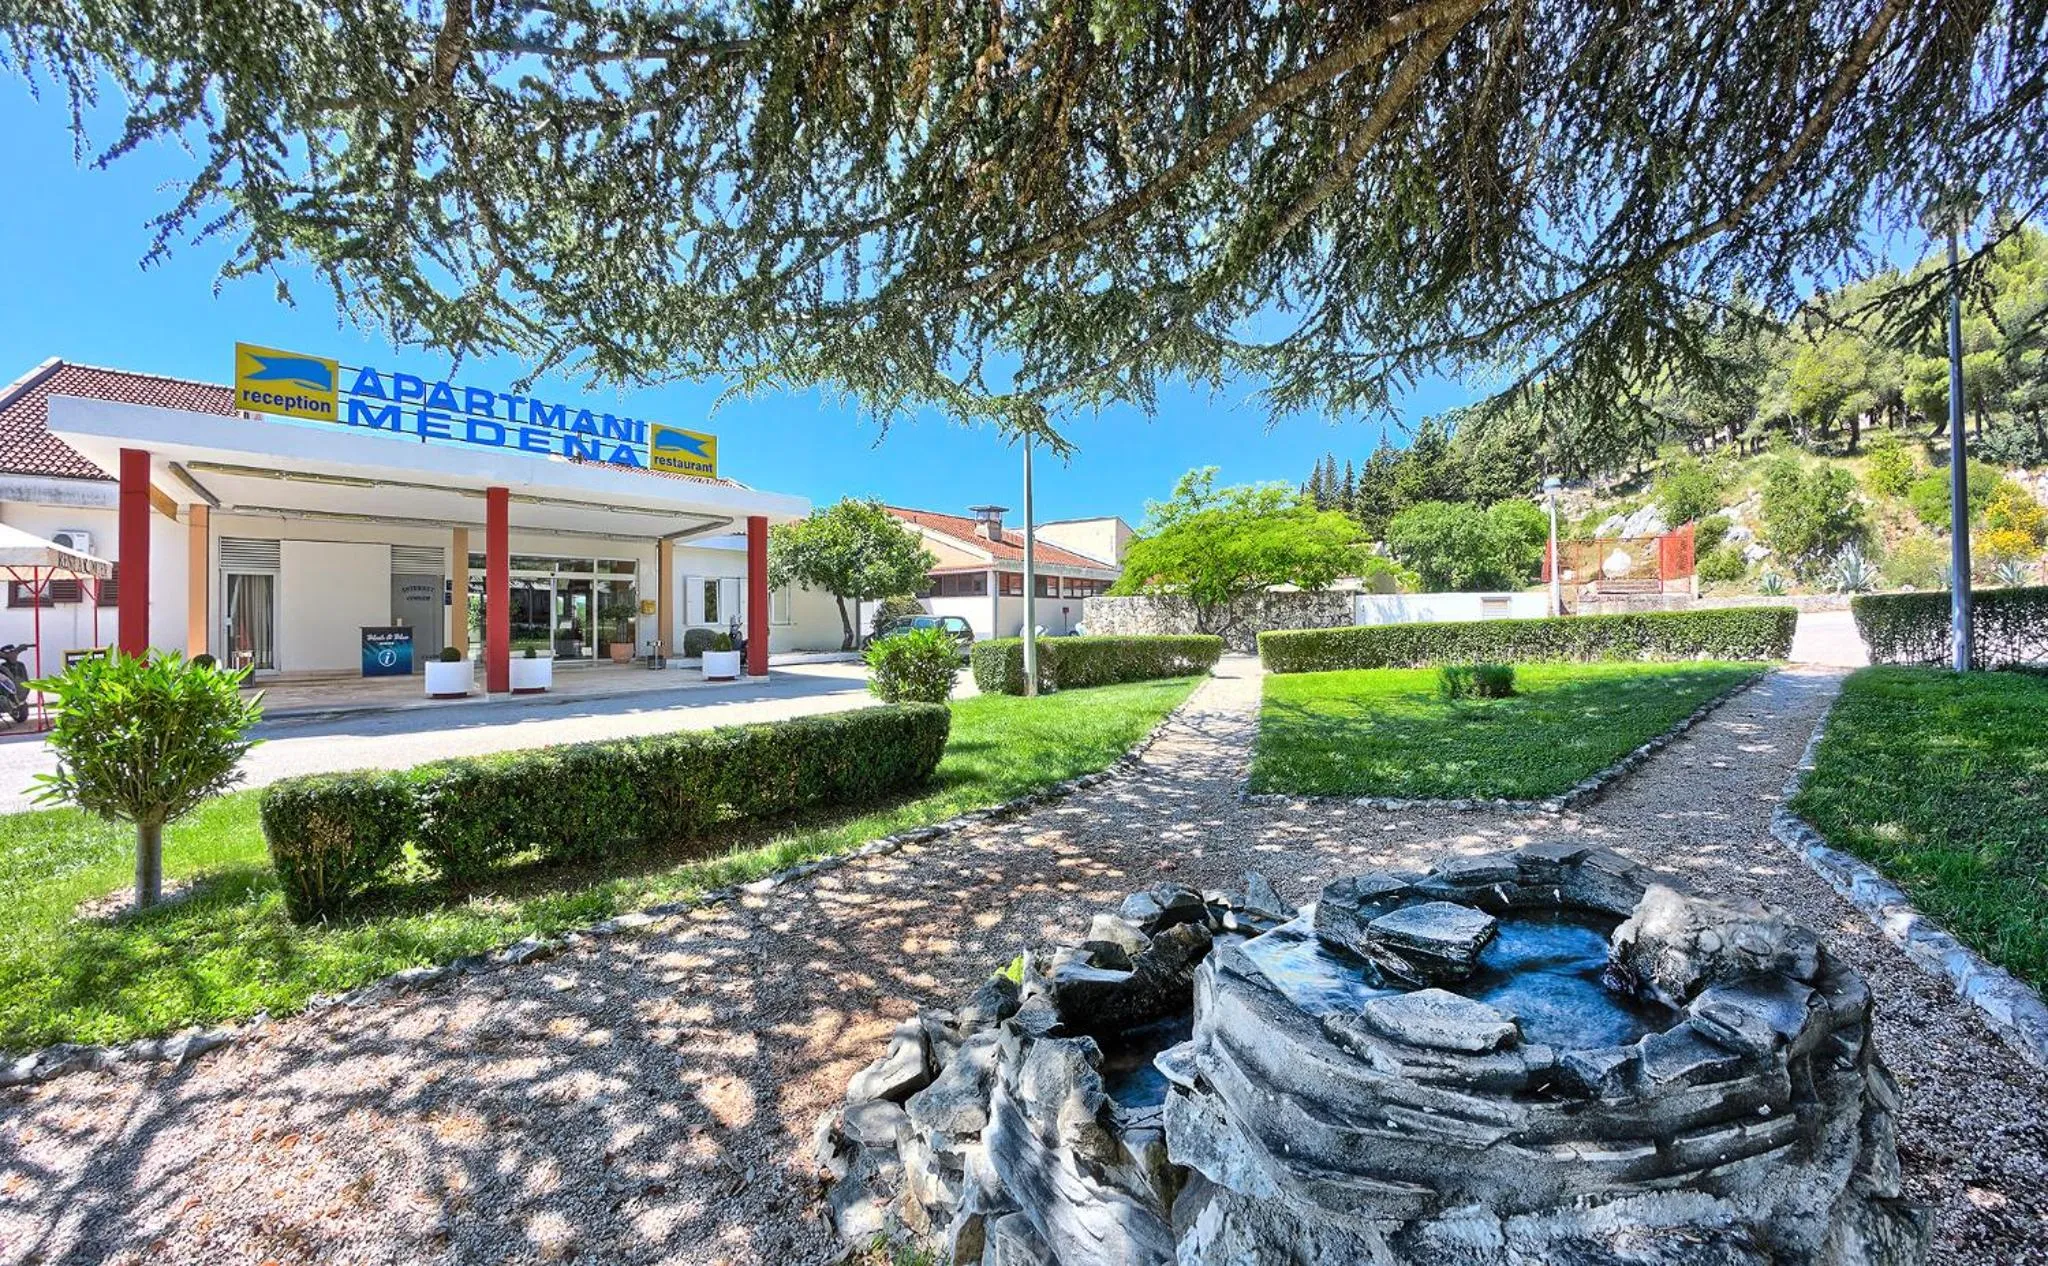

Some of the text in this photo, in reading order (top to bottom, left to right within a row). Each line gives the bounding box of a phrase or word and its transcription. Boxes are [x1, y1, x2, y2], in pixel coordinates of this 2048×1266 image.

[242, 389, 332, 413] reception
[350, 366, 644, 445] APARTMANI
[348, 399, 642, 467] MEDENA
[654, 455, 713, 474] restaurant
